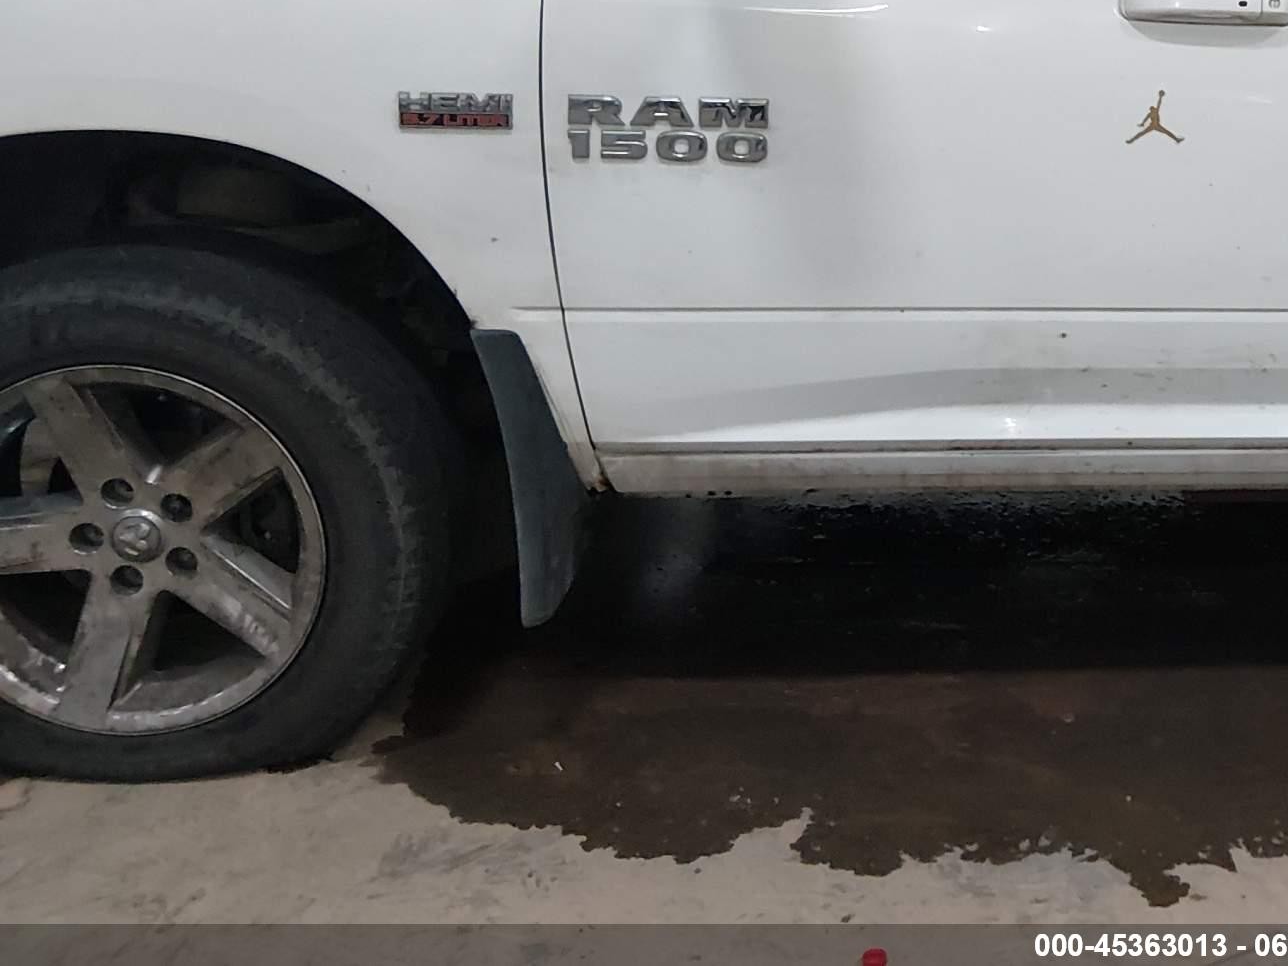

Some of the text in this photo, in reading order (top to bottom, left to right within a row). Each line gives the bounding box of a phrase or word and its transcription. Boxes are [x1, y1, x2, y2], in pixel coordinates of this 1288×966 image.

[399, 91, 513, 114] HEMI
[568, 94, 769, 128] RAM
[567, 129, 769, 164] 1500
